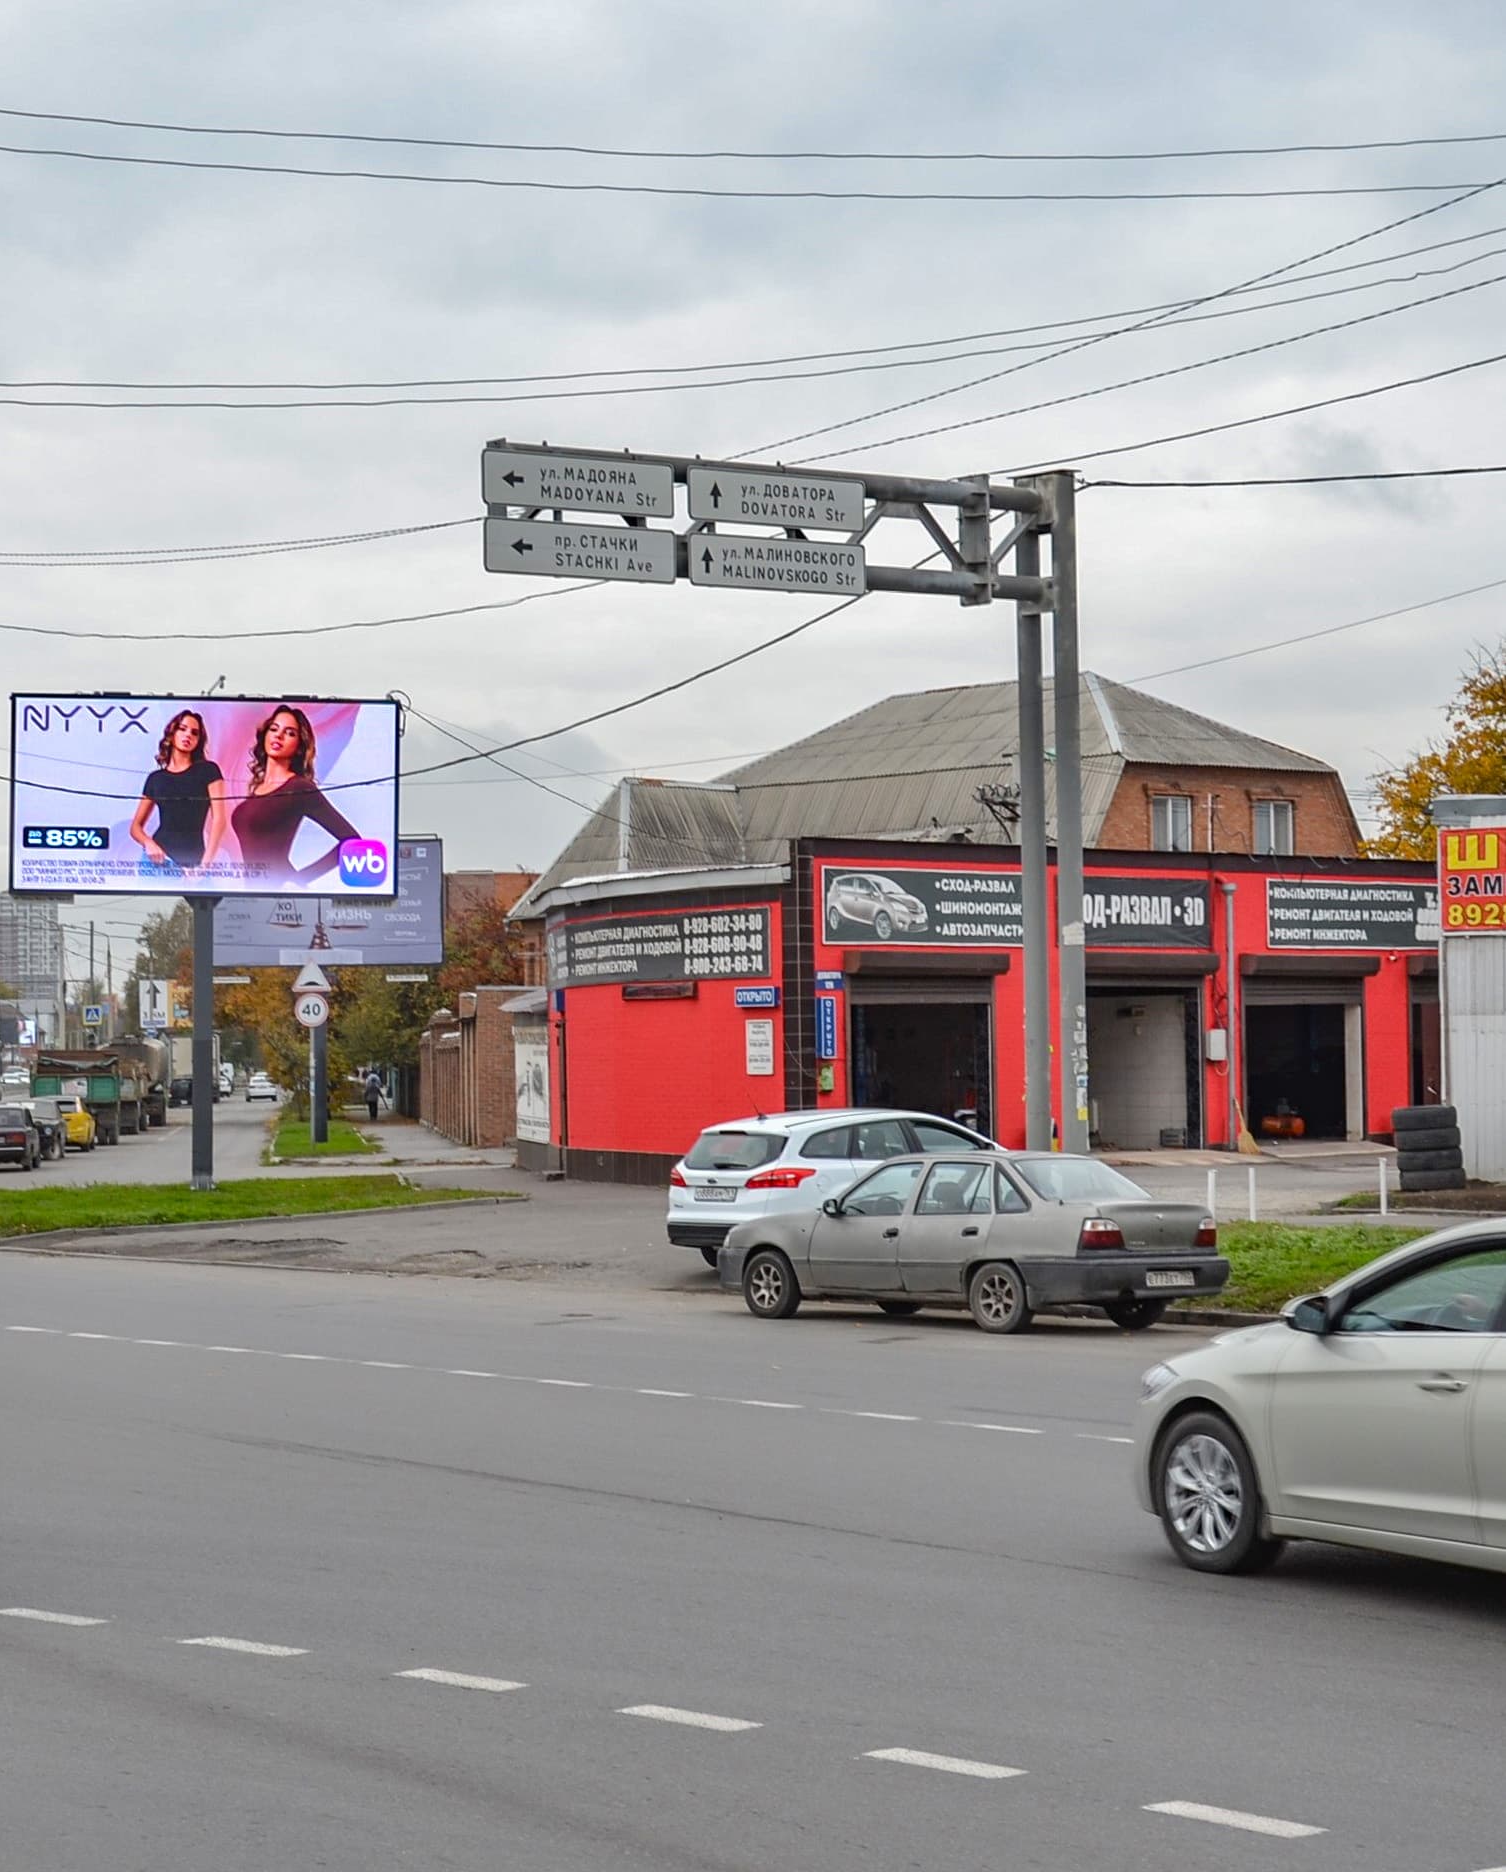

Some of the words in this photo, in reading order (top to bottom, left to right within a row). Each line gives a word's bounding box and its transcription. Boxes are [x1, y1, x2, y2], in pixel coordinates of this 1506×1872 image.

[540, 485, 625, 504] MADOYANA
[636, 492, 657, 507] Str
[741, 501, 815, 519] DOVATORA
[825, 508, 845, 522] Str
[555, 552, 618, 570] STACHKI
[626, 559, 653, 572] Ave
[722, 565, 828, 584] MALINOVSKOGO
[836, 572, 857, 586] Str
[23, 704, 149, 734] NYYX
[342, 848, 385, 873] wb
[941, 878, 1015, 893] СХОД-РАЗВАЛ
[1274, 887, 1349, 901] КОМПЬЮТЕРНАЯ
[1350, 889, 1414, 902] ДИАГНОСТИКА
[1447, 875, 1506, 897] ЗАМ
[941, 901, 1023, 916] ШИНОМОНТАЖ
[1083, 893, 1172, 928] ОД-РАЗВАЛ
[1183, 896, 1205, 926] 3D
[1274, 908, 1310, 921] РЕМОНТ
[1312, 909, 1361, 922] ДВИГАТЕЛЯ
[1362, 911, 1369, 921] И
[1370, 908, 1413, 922] ХОДОВОЙ
[574, 927, 622, 945] КОМПЬЮТЕРНАЯ
[623, 923, 679, 940] ДИАГНОСТИКА
[1275, 928, 1311, 940] РЕМОНТ
[1313, 928, 1368, 941] ИНЖЕКТОРА
[575, 948, 597, 961] РЕМОНТ
[597, 944, 634, 959] ДВИГАТЕЛЯ
[636, 944, 642, 956] И
[643, 939, 682, 956] ХОДОВОЙ
[575, 963, 596, 977] РЕМОНТ
[737, 990, 772, 1003] ОТКРЫТО
[301, 1003, 321, 1016] 40
[825, 999, 833, 1056] ОТКРЫТО
